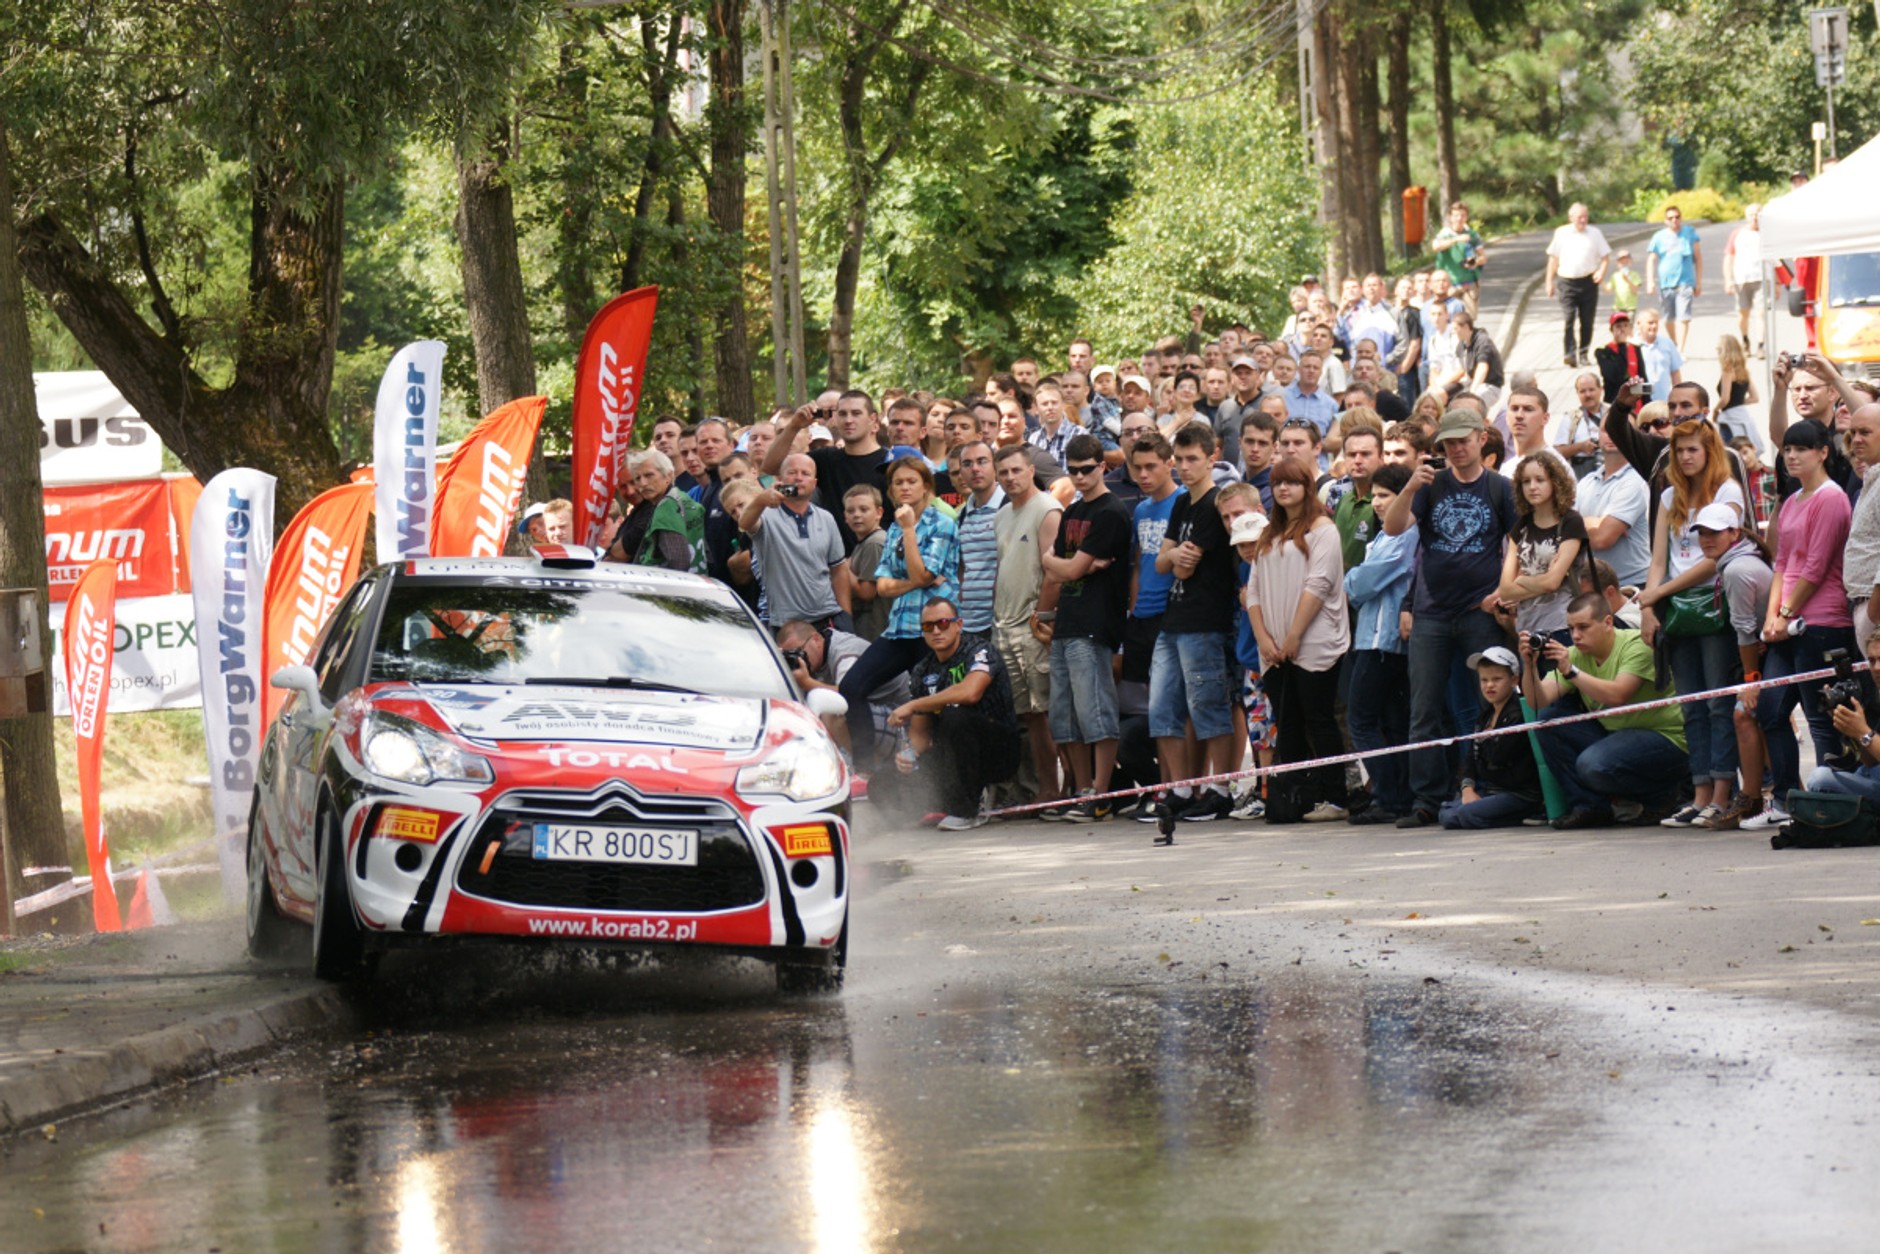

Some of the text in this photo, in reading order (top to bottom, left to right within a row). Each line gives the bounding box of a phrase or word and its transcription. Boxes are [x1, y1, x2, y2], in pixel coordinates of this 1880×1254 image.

[40, 416, 147, 448] US
[394, 362, 427, 561] Warner
[46, 528, 146, 562] num
[326, 546, 349, 595] OIL
[218, 487, 257, 792] BorgWarner
[81, 618, 107, 733] ORLEN OIL
[604, 722, 655, 732] doradca
[538, 746, 689, 775] TOTAL
[535, 844, 547, 855] PL
[553, 828, 689, 862] KR 800SJ
[528, 917, 697, 942] www.korab2.pl
